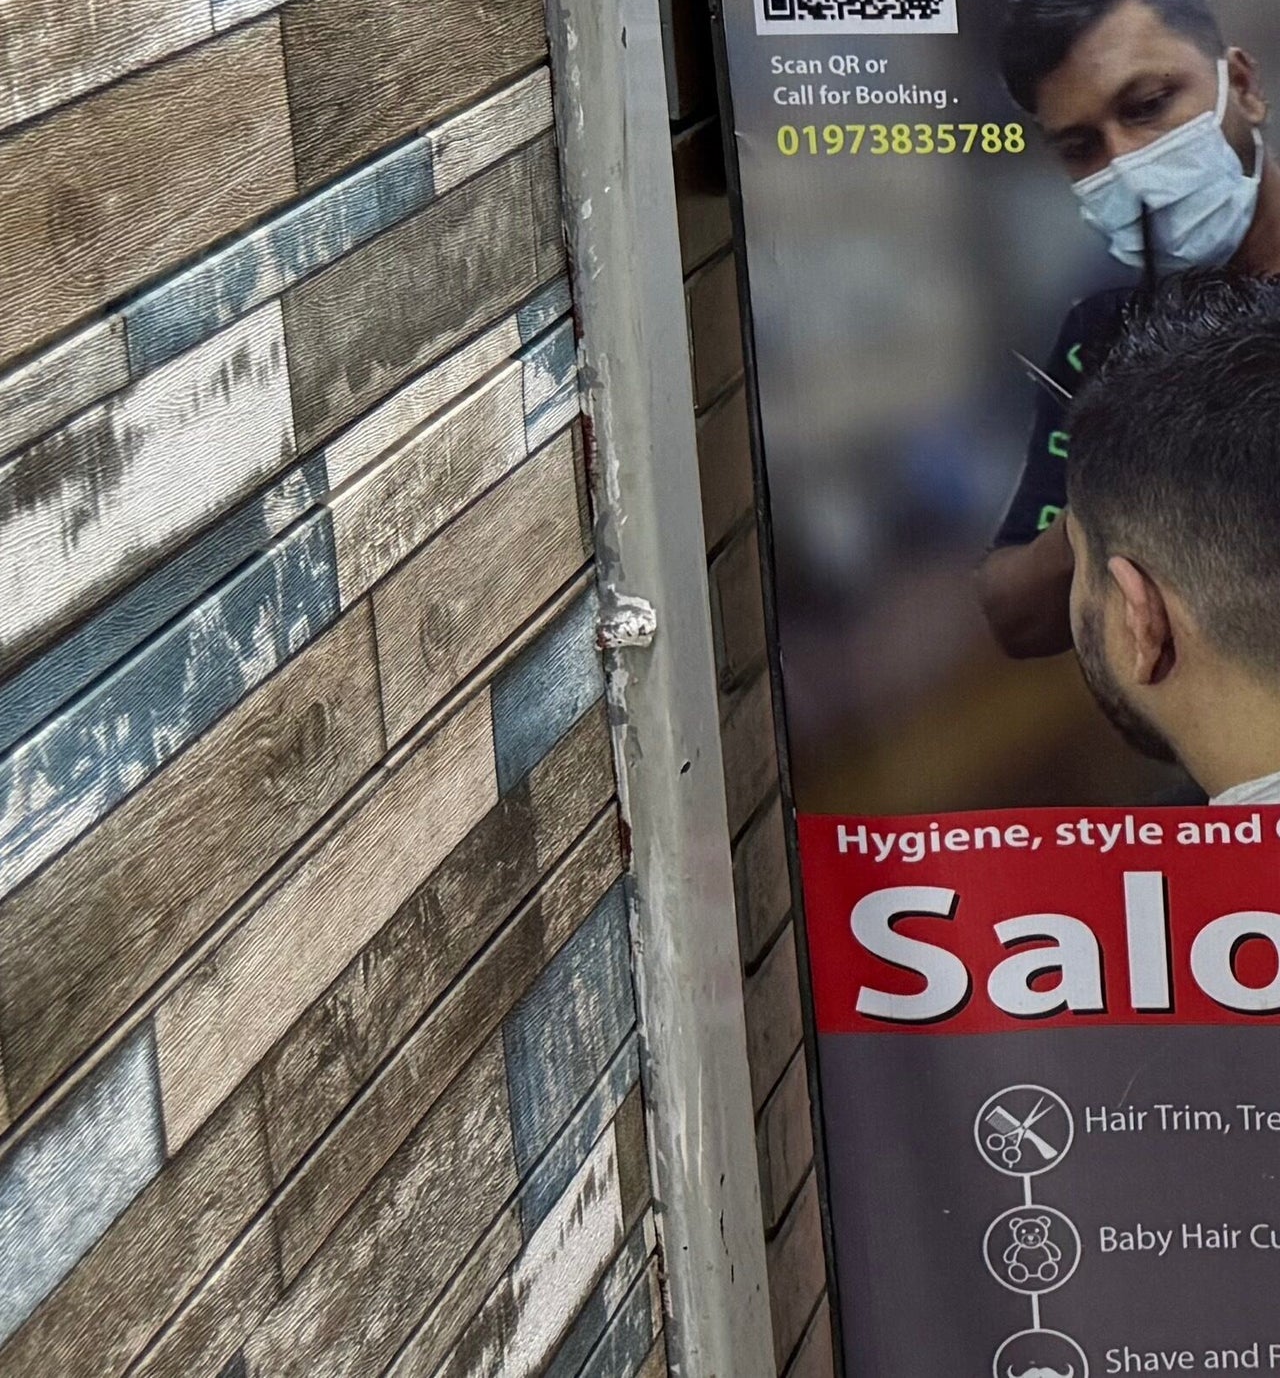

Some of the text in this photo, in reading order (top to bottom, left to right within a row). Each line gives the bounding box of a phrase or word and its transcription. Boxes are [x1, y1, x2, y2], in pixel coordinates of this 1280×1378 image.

[771, 55, 888, 75] Scan QR or
[773, 85, 814, 106] Call
[819, 85, 850, 105] for
[856, 84, 948, 109] Booking
[777, 123, 1025, 156] 01973835788
[836, 823, 1043, 862] Hygiene,
[1055, 815, 1164, 861] style
[1176, 813, 1263, 844] and
[1085, 1105, 1148, 1133] Hair
[1154, 1104, 1230, 1135] Trim,
[1099, 1226, 1172, 1257] Baby
[1181, 1224, 1242, 1250] Hair
[1105, 1345, 1195, 1373] Shave
[1204, 1344, 1260, 1371] and
